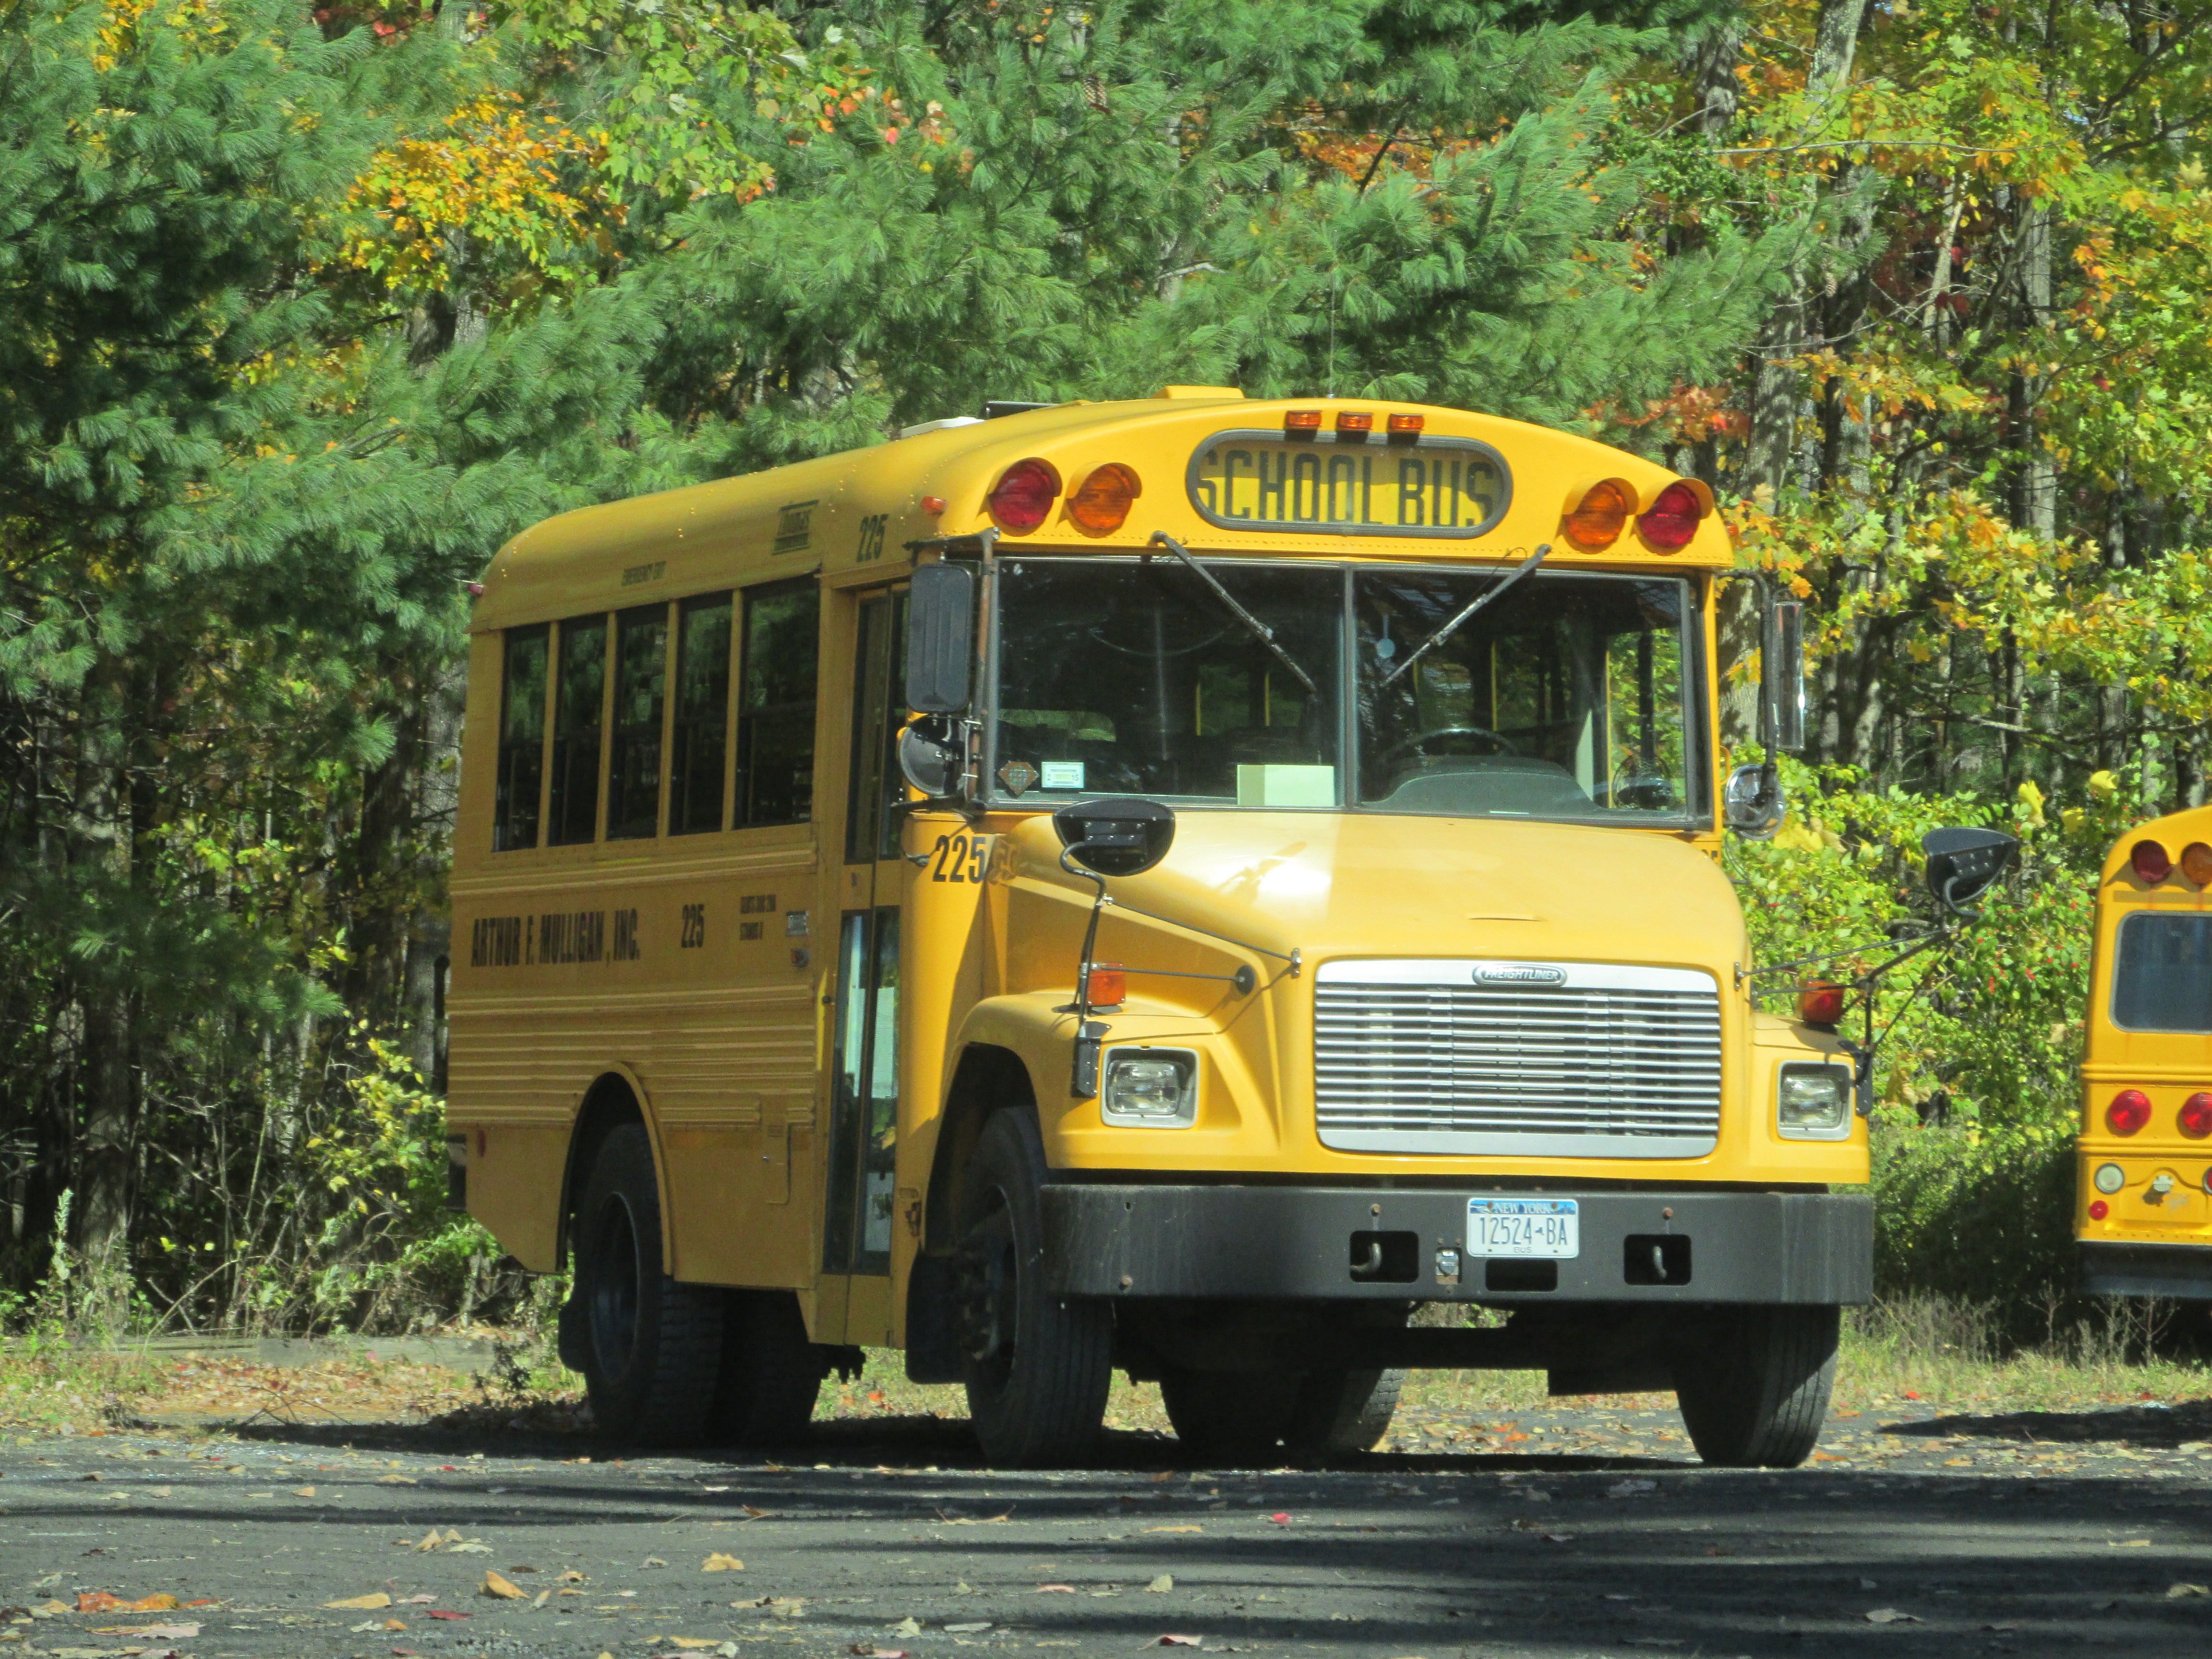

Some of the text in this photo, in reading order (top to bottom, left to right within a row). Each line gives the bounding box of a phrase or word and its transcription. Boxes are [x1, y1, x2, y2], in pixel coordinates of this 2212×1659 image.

[1197, 449, 1494, 527] SCHOOL BUS
[856, 514, 889, 563] 225
[933, 835, 986, 884] 225
[470, 916, 521, 967] ARTHUR
[681, 903, 704, 948] 225
[1484, 968, 1560, 980] FREIGHTLINER
[1495, 1202, 1551, 1214] NEW YORK
